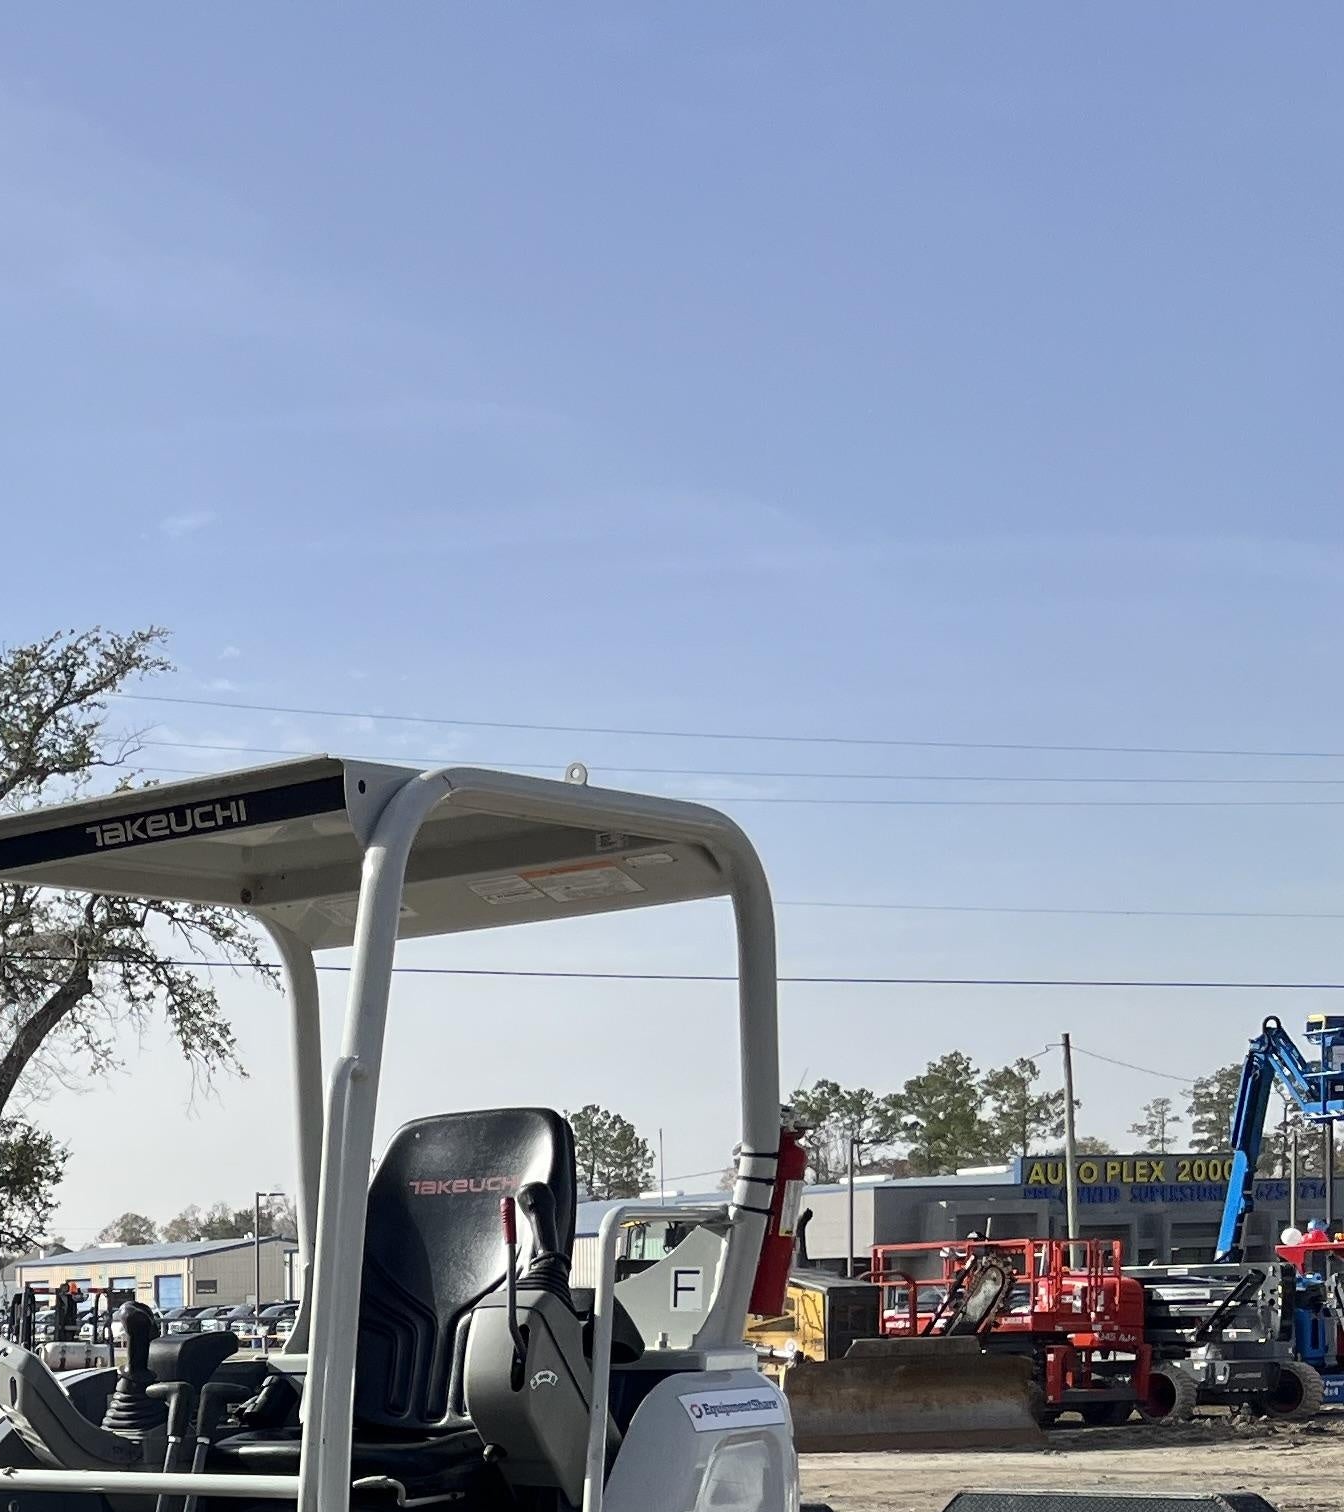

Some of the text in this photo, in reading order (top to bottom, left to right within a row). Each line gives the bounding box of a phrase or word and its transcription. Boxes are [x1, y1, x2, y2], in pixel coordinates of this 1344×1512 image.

[86, 800, 247, 846] TAKEUCHI
[1028, 1161, 1099, 1184] AUO
[1106, 1160, 1165, 1183] PLEX
[674, 1269, 701, 1308] F
[703, 1400, 778, 1417] EquipmentShare
